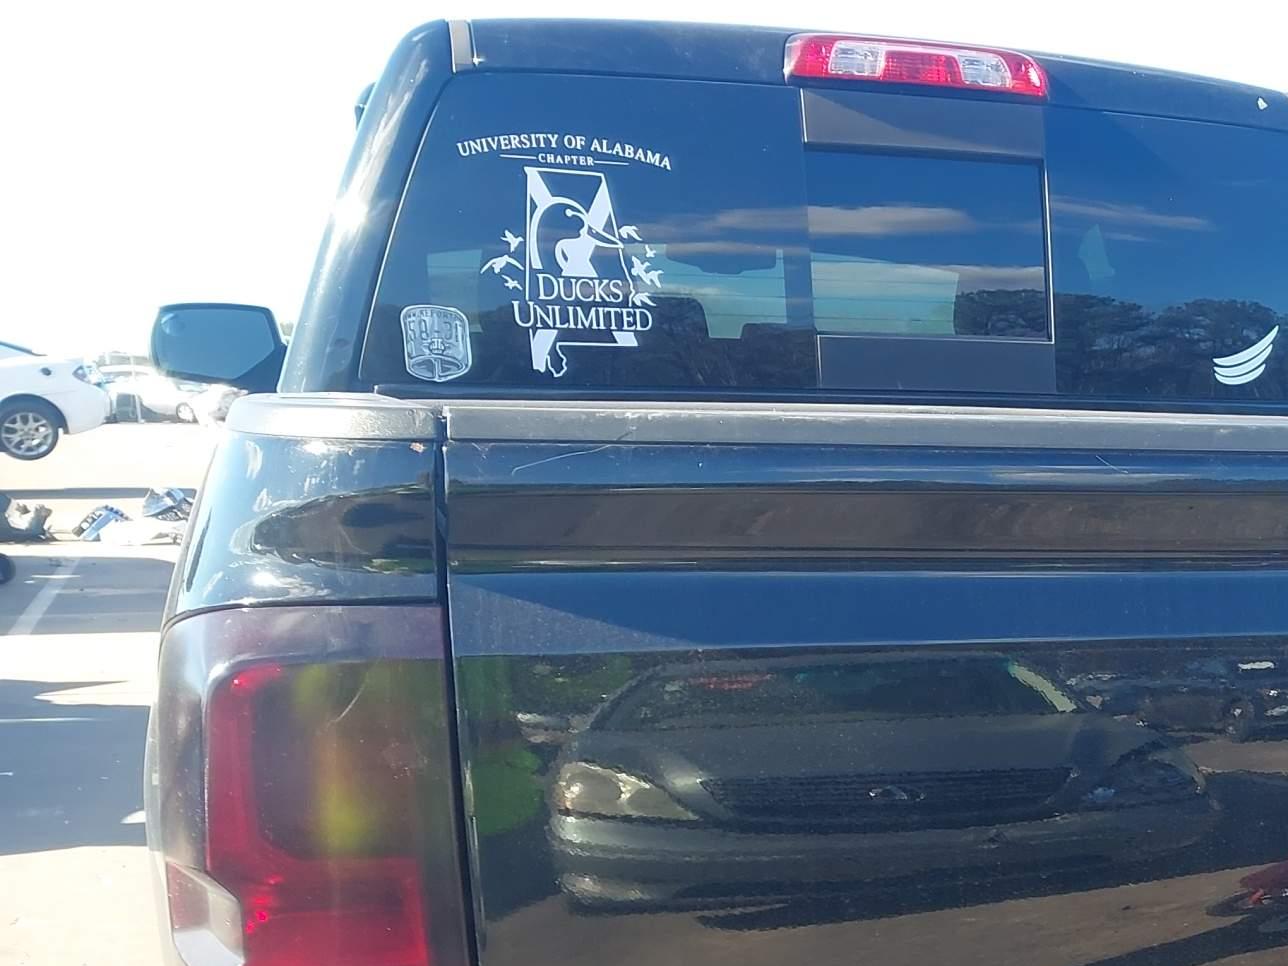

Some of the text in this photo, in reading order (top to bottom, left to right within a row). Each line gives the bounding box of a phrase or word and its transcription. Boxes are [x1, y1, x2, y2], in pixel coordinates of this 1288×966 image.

[456, 133, 672, 170] UNIVERSITY OF ALABAMA
[537, 153, 595, 166] CHAPTER
[536, 273, 623, 303] DUCKS
[511, 300, 653, 331] UNLIMITED
